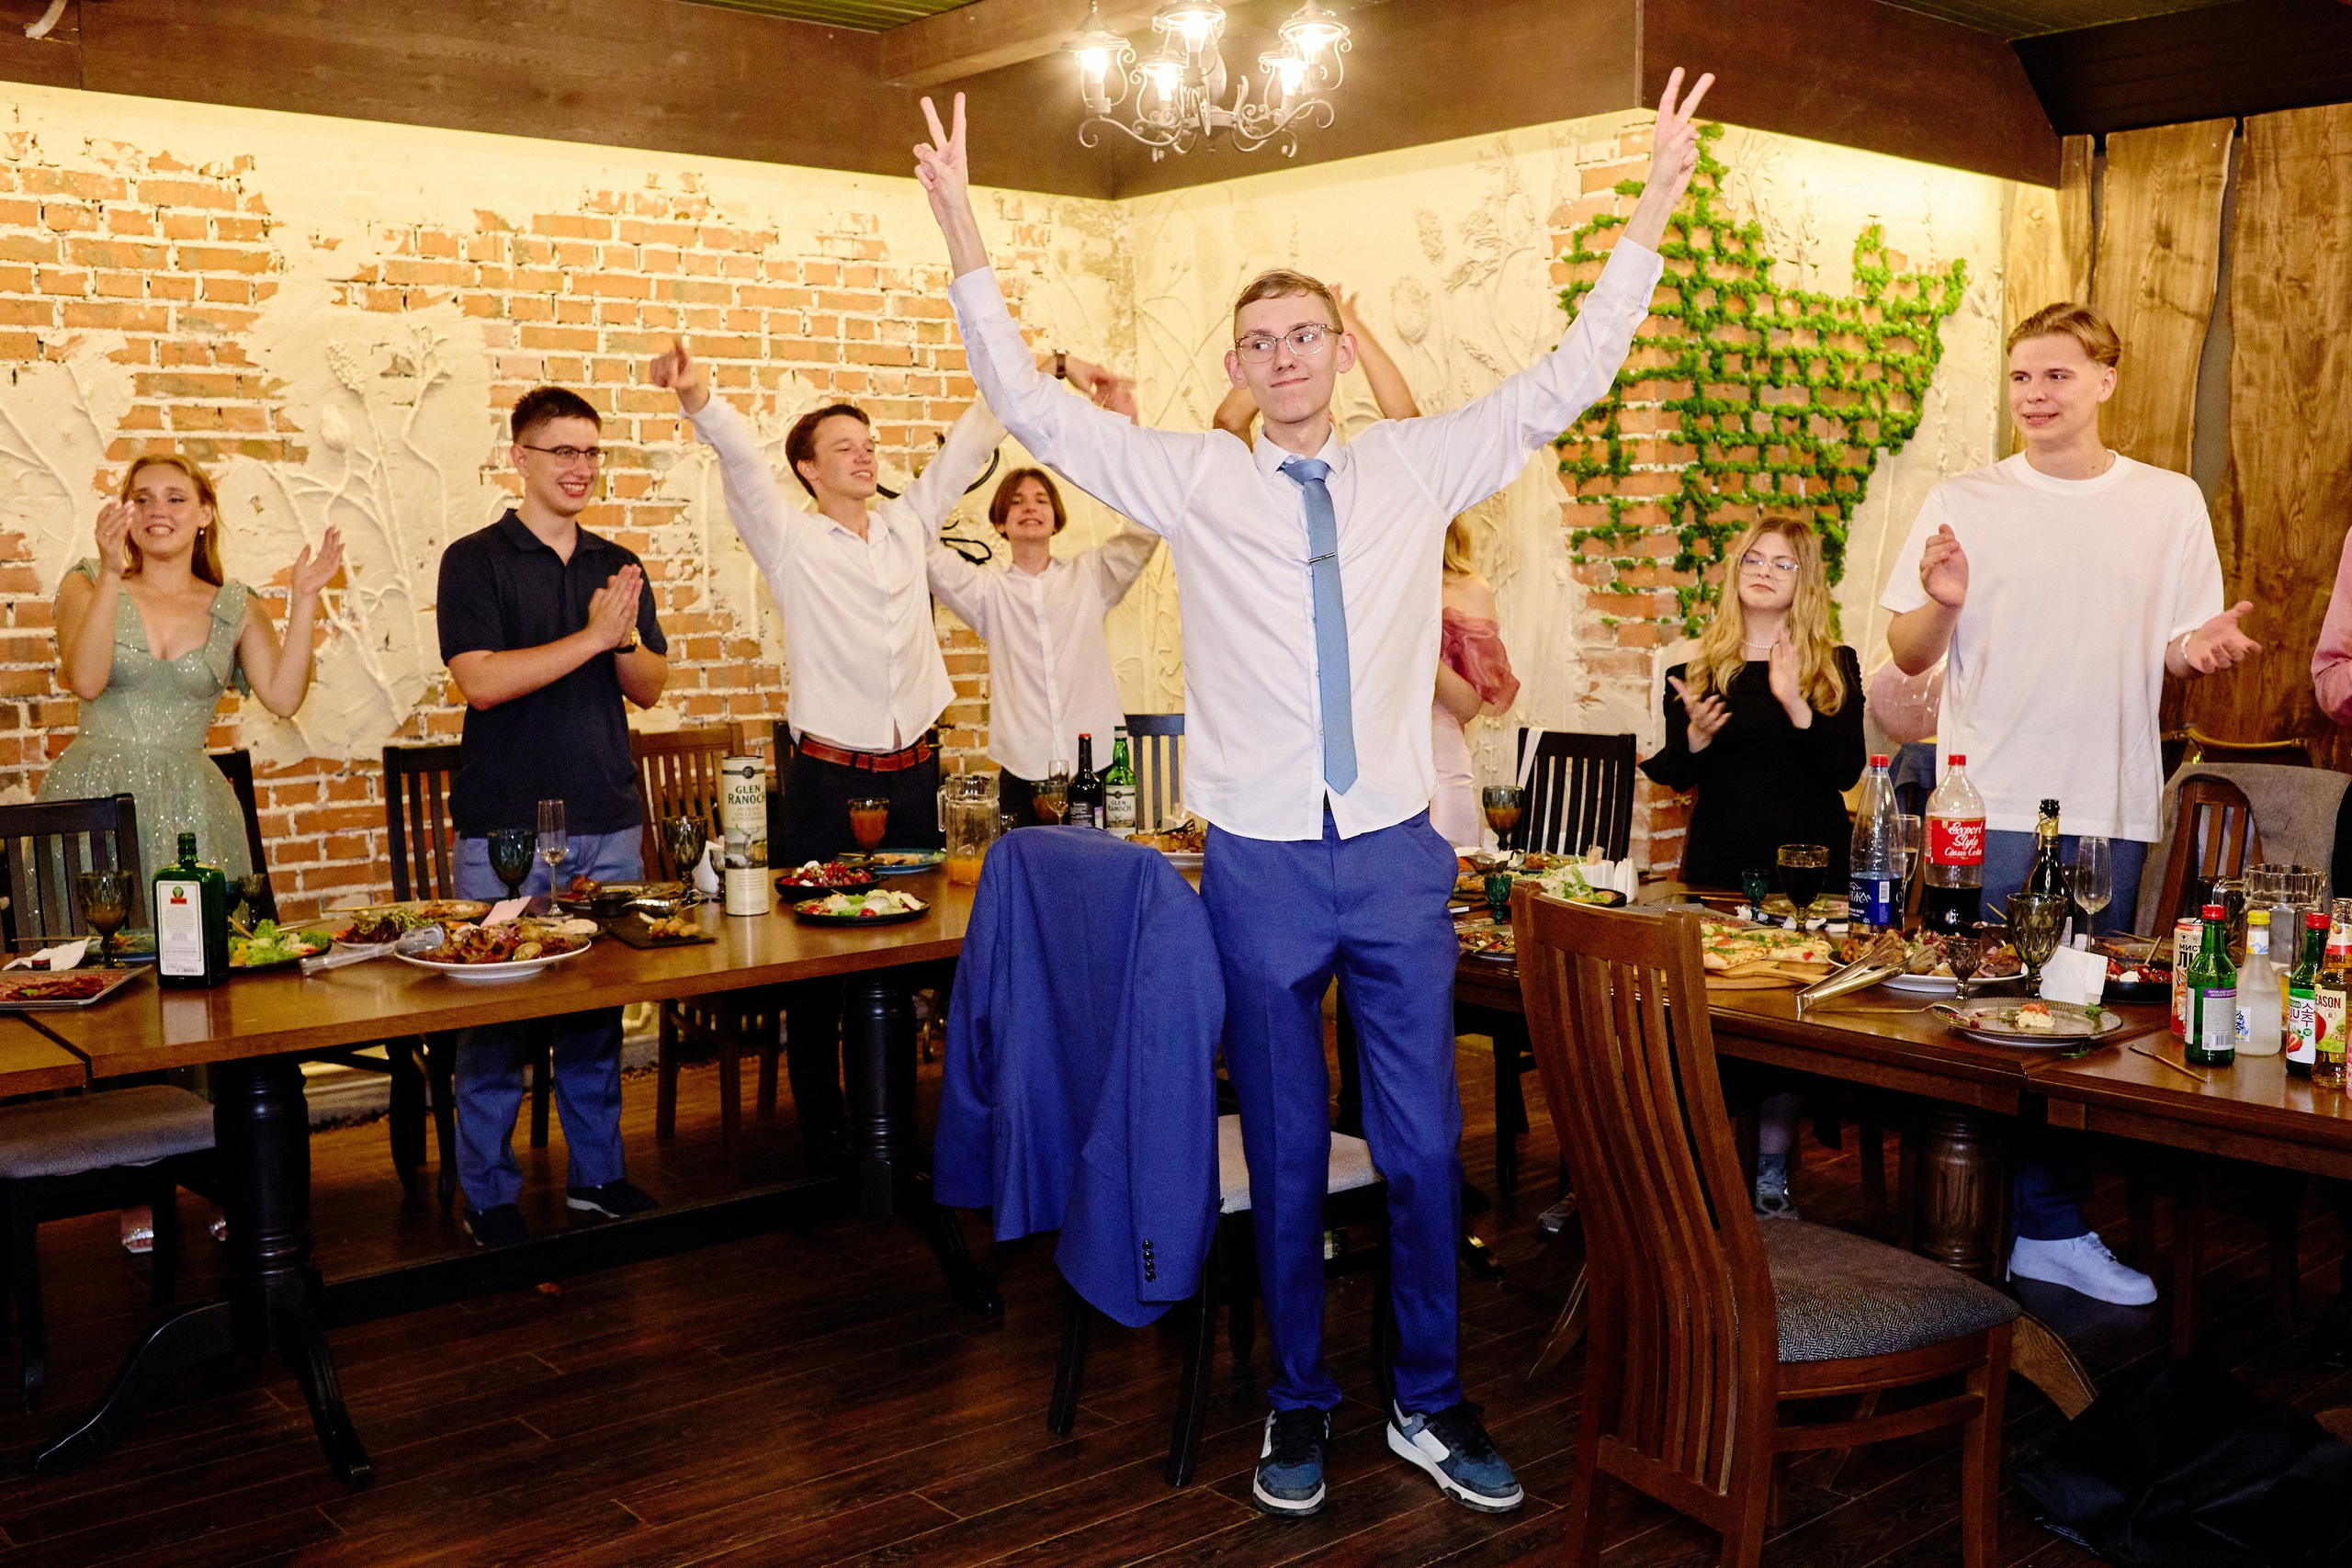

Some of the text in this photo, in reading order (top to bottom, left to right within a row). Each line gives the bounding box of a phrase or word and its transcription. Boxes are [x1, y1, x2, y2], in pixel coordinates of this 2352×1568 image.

[736, 784, 761, 794] GLEN
[1948, 821, 1984, 840] Export
[1952, 834, 1979, 850] Style
[2314, 994, 2341, 1009] EASON
[2301, 1002, 2314, 1027] 소주
